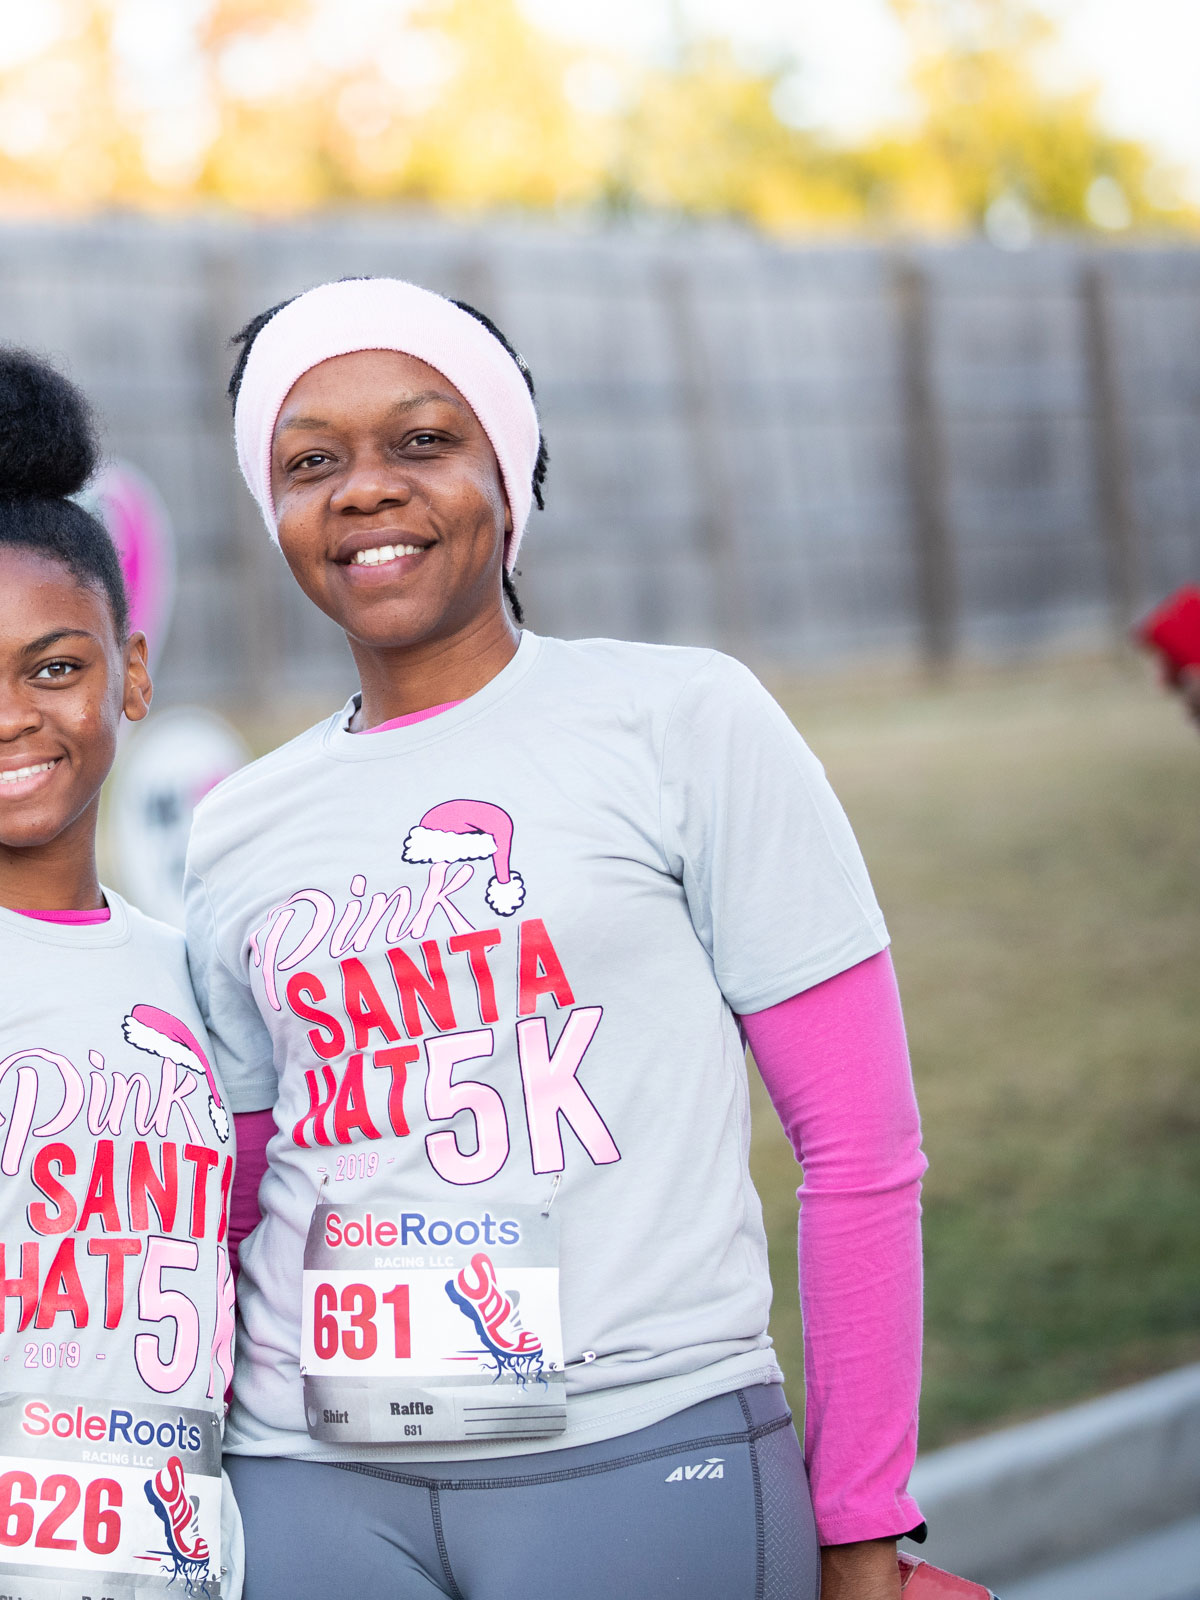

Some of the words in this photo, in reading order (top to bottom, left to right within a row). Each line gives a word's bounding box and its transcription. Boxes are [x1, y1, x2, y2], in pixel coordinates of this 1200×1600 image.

[250, 862, 476, 1010] Pink
[286, 918, 575, 1060] SANTA
[292, 1045, 420, 1148] HAT
[424, 1005, 621, 1185] 5K
[324, 1212, 521, 1248] SoleRoots
[374, 1256, 425, 1269] RACING
[428, 1255, 455, 1268] LLC
[313, 1283, 412, 1361] 631
[323, 1409, 349, 1424] Shirt
[390, 1402, 434, 1416] Raffle
[22, 1402, 202, 1451] SoleRoots
[403, 1424, 423, 1437] 631
[81, 1450, 130, 1465] RACING
[133, 1454, 154, 1467] LLC
[664, 1458, 726, 1482] AVIA
